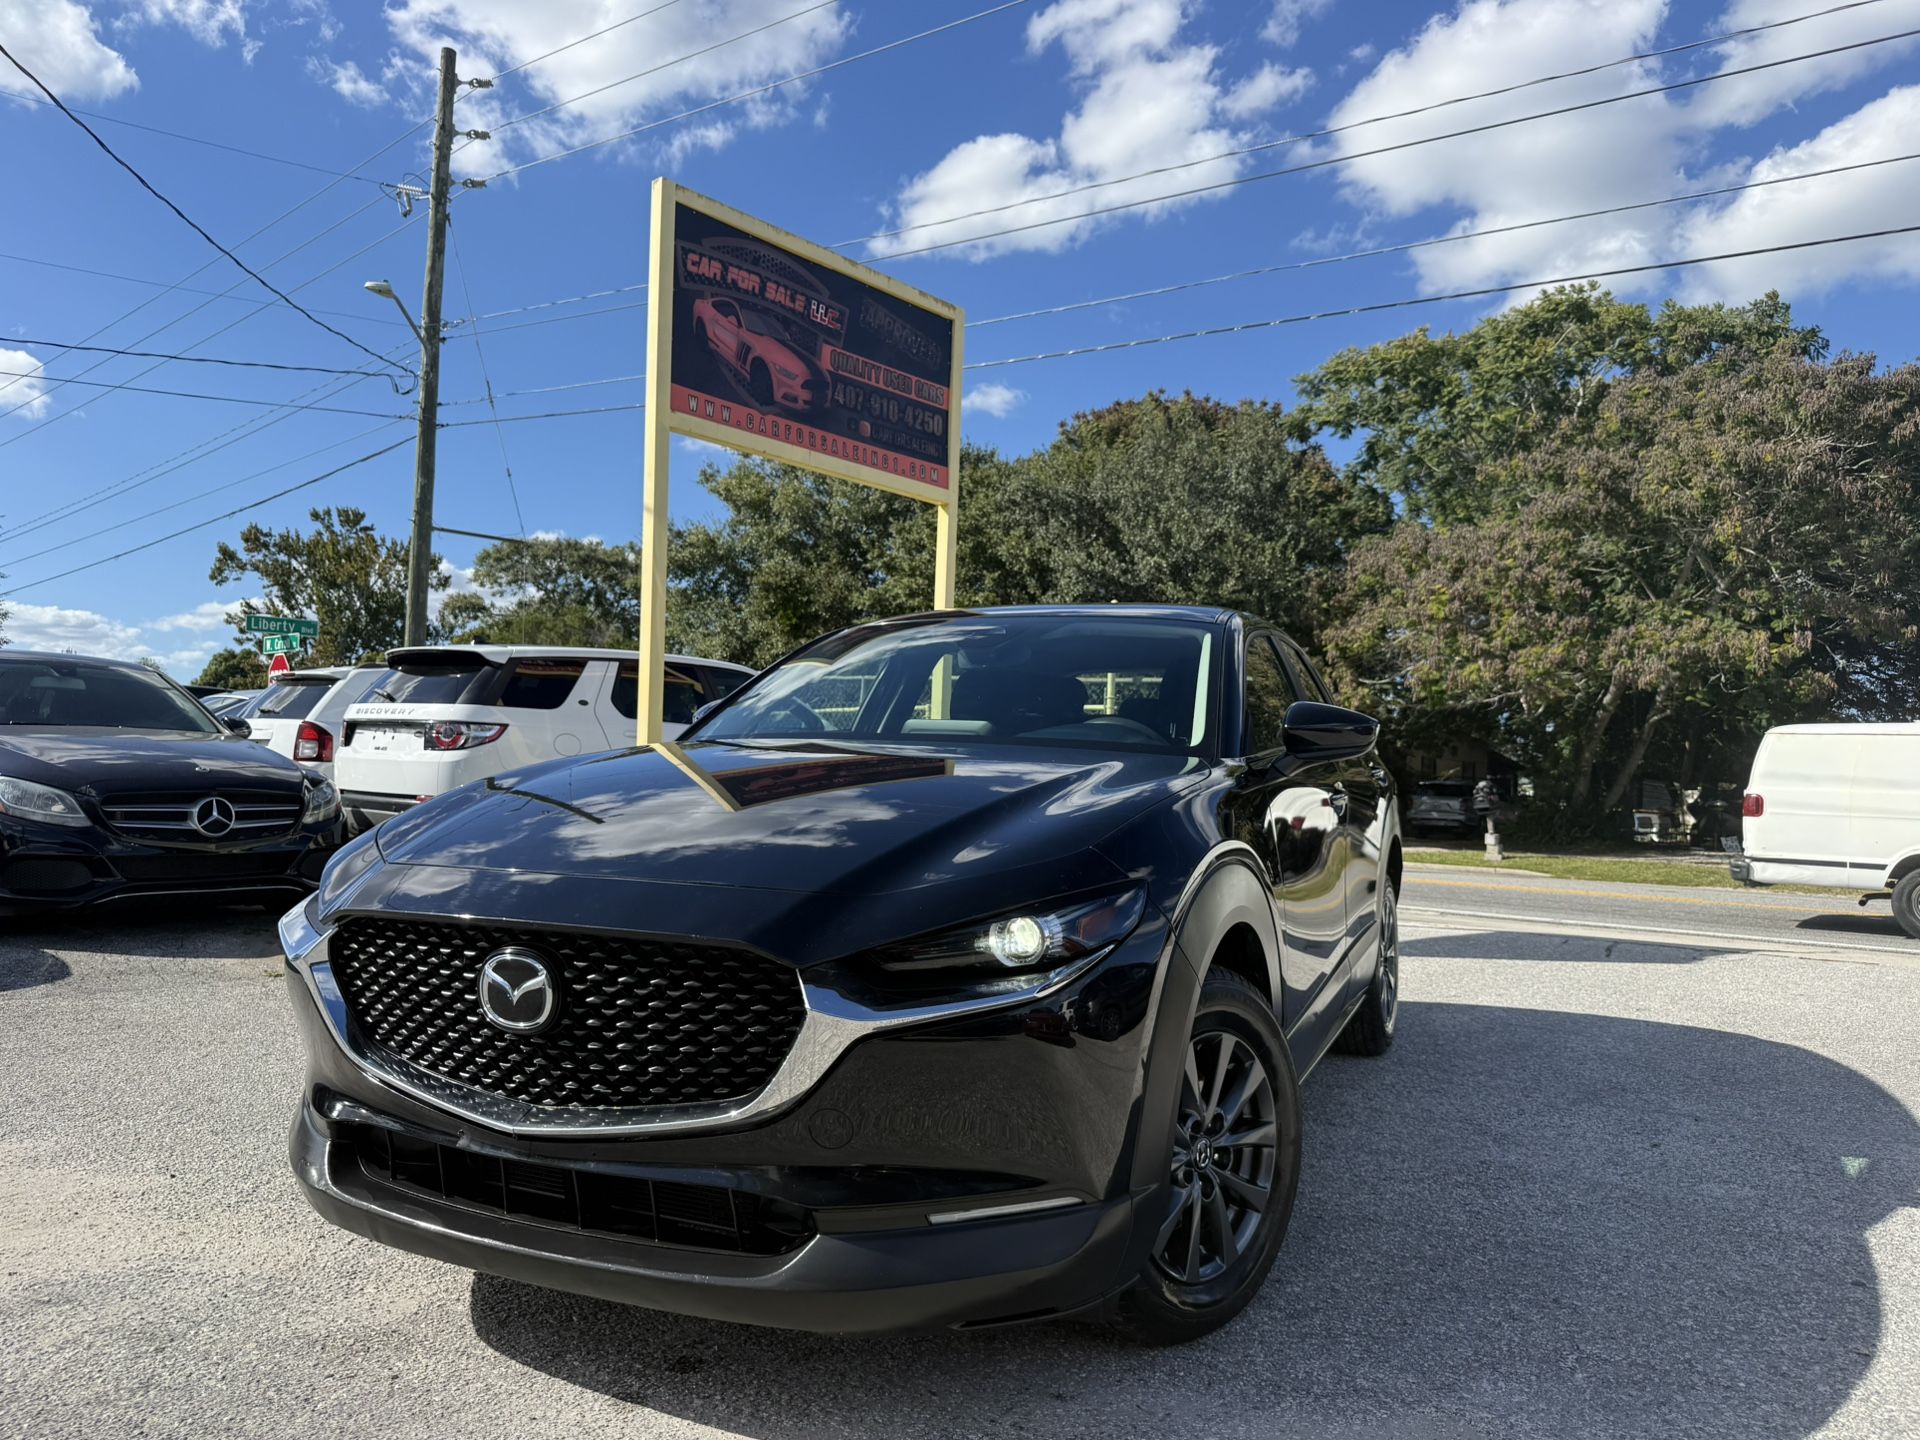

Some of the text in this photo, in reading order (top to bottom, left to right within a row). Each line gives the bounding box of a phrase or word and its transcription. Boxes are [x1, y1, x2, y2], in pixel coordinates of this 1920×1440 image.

[687, 253, 842, 329] CAR FOR SALE LLC
[830, 349, 945, 405] QUALITY USED CARS
[834, 383, 943, 436] 407-910-4250
[687, 394, 940, 482] WWW.CARFORSALEINC1.COM
[251, 617, 296, 633] Liberty
[355, 707, 415, 715] DISCOVERY
